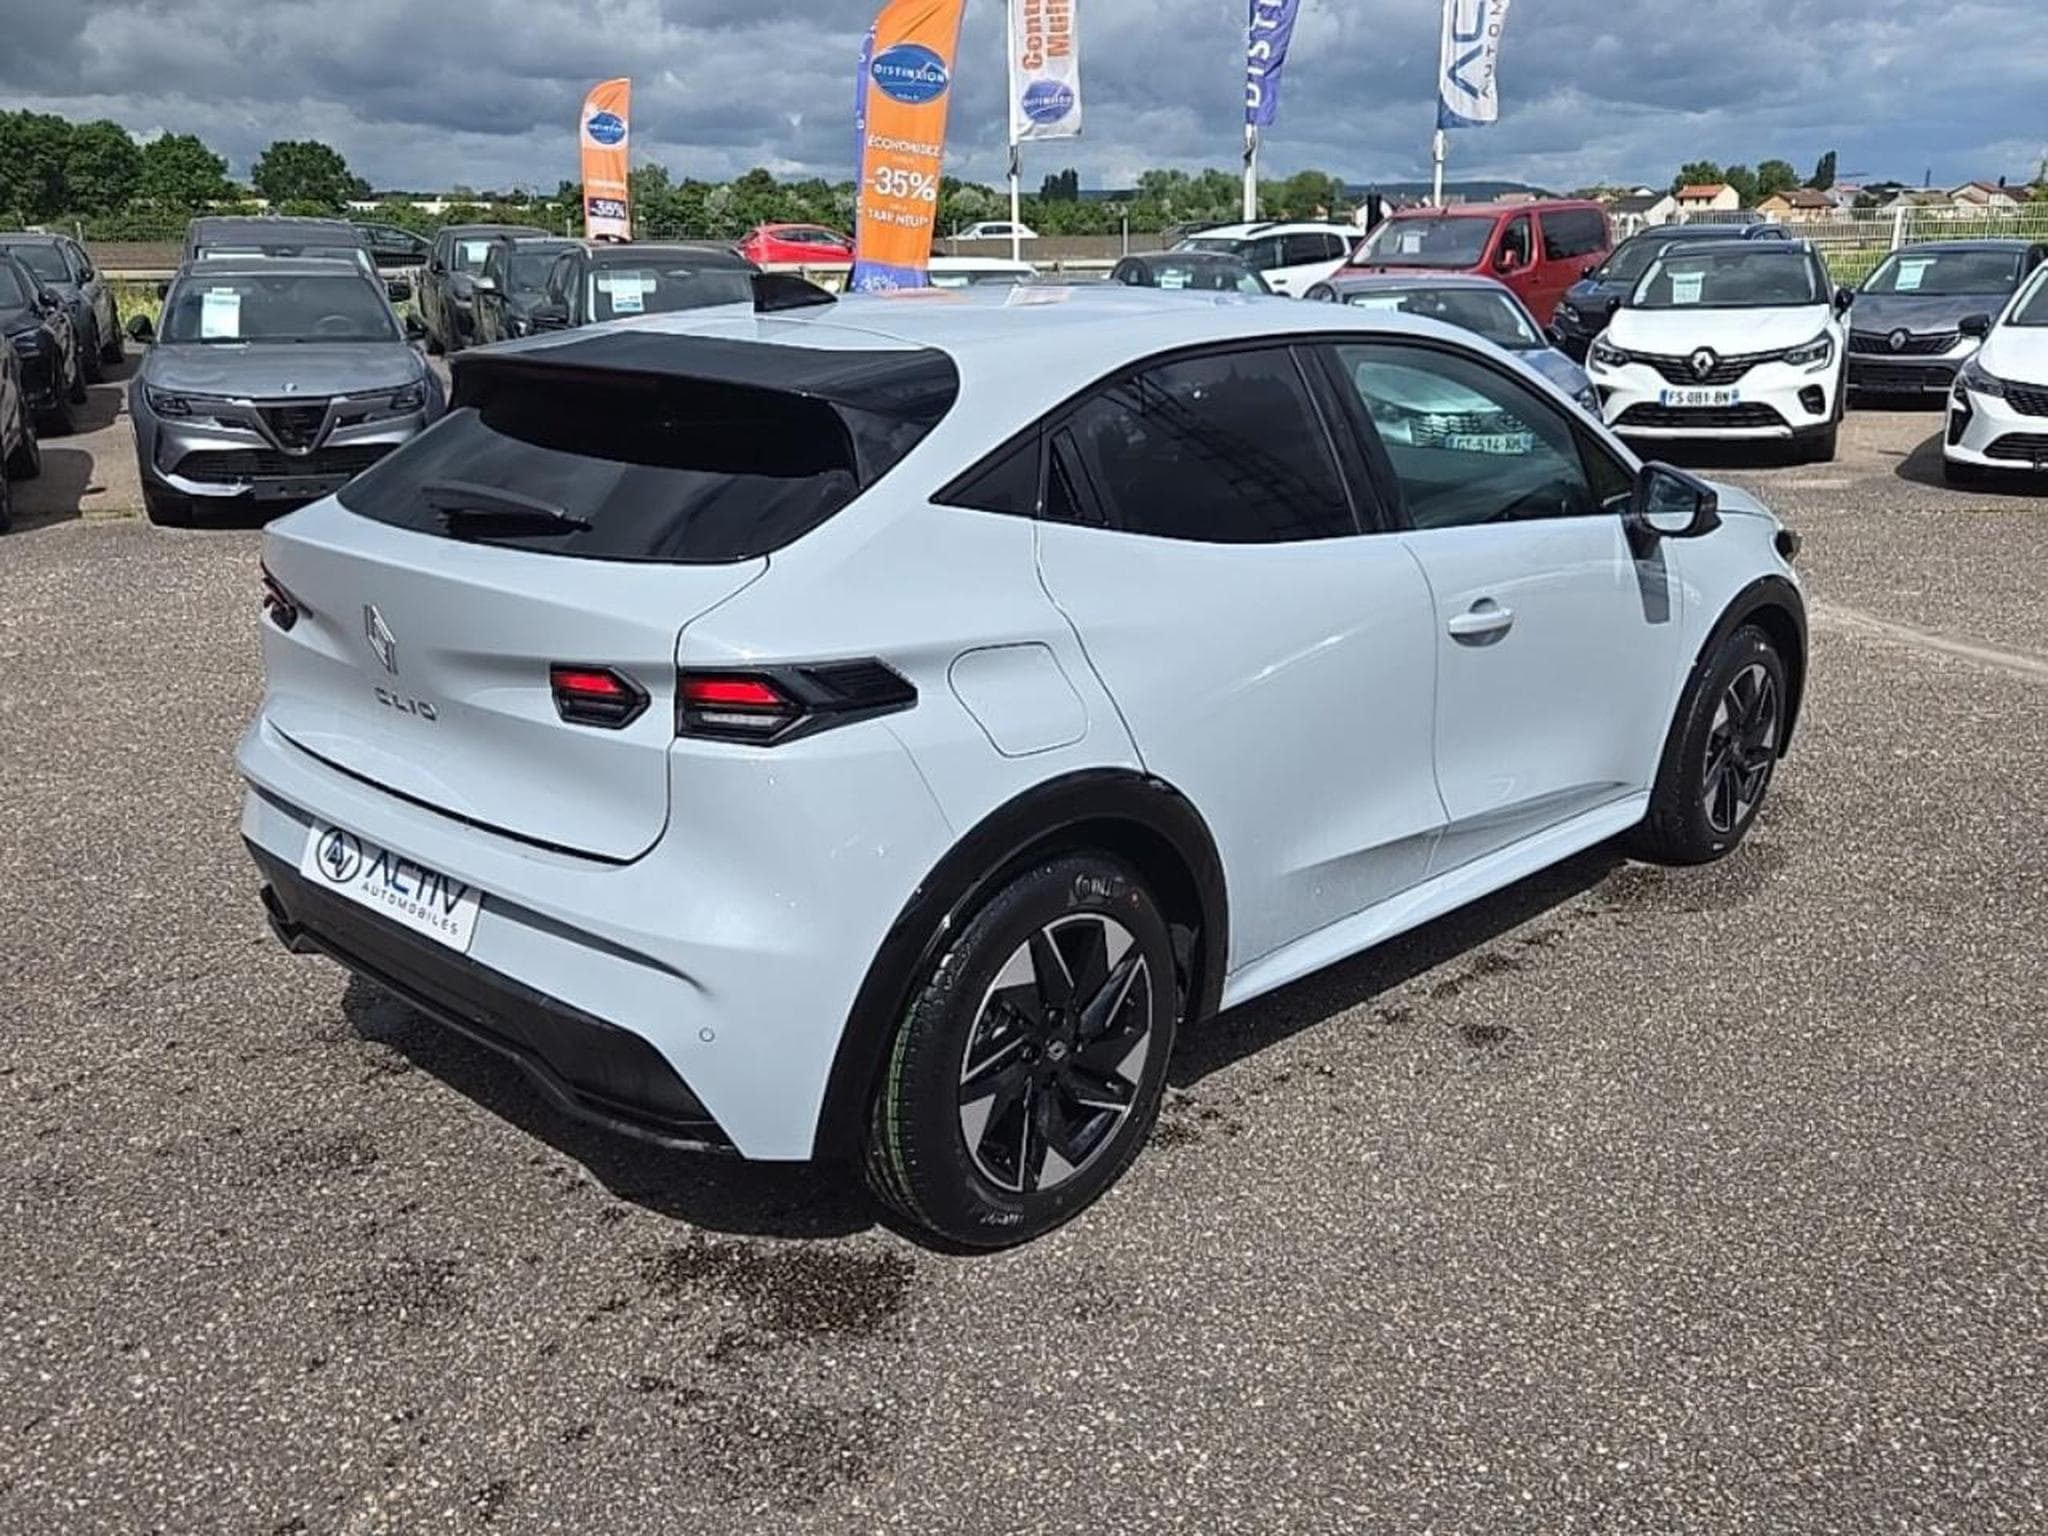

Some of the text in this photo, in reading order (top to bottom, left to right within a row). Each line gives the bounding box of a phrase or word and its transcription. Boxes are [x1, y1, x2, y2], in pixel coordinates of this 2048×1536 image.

[865, 166, 936, 201] -35%
[374, 686, 437, 721] CLIO
[366, 849, 469, 916] ACTIV
[362, 882, 458, 936] AUTOMOBILES
